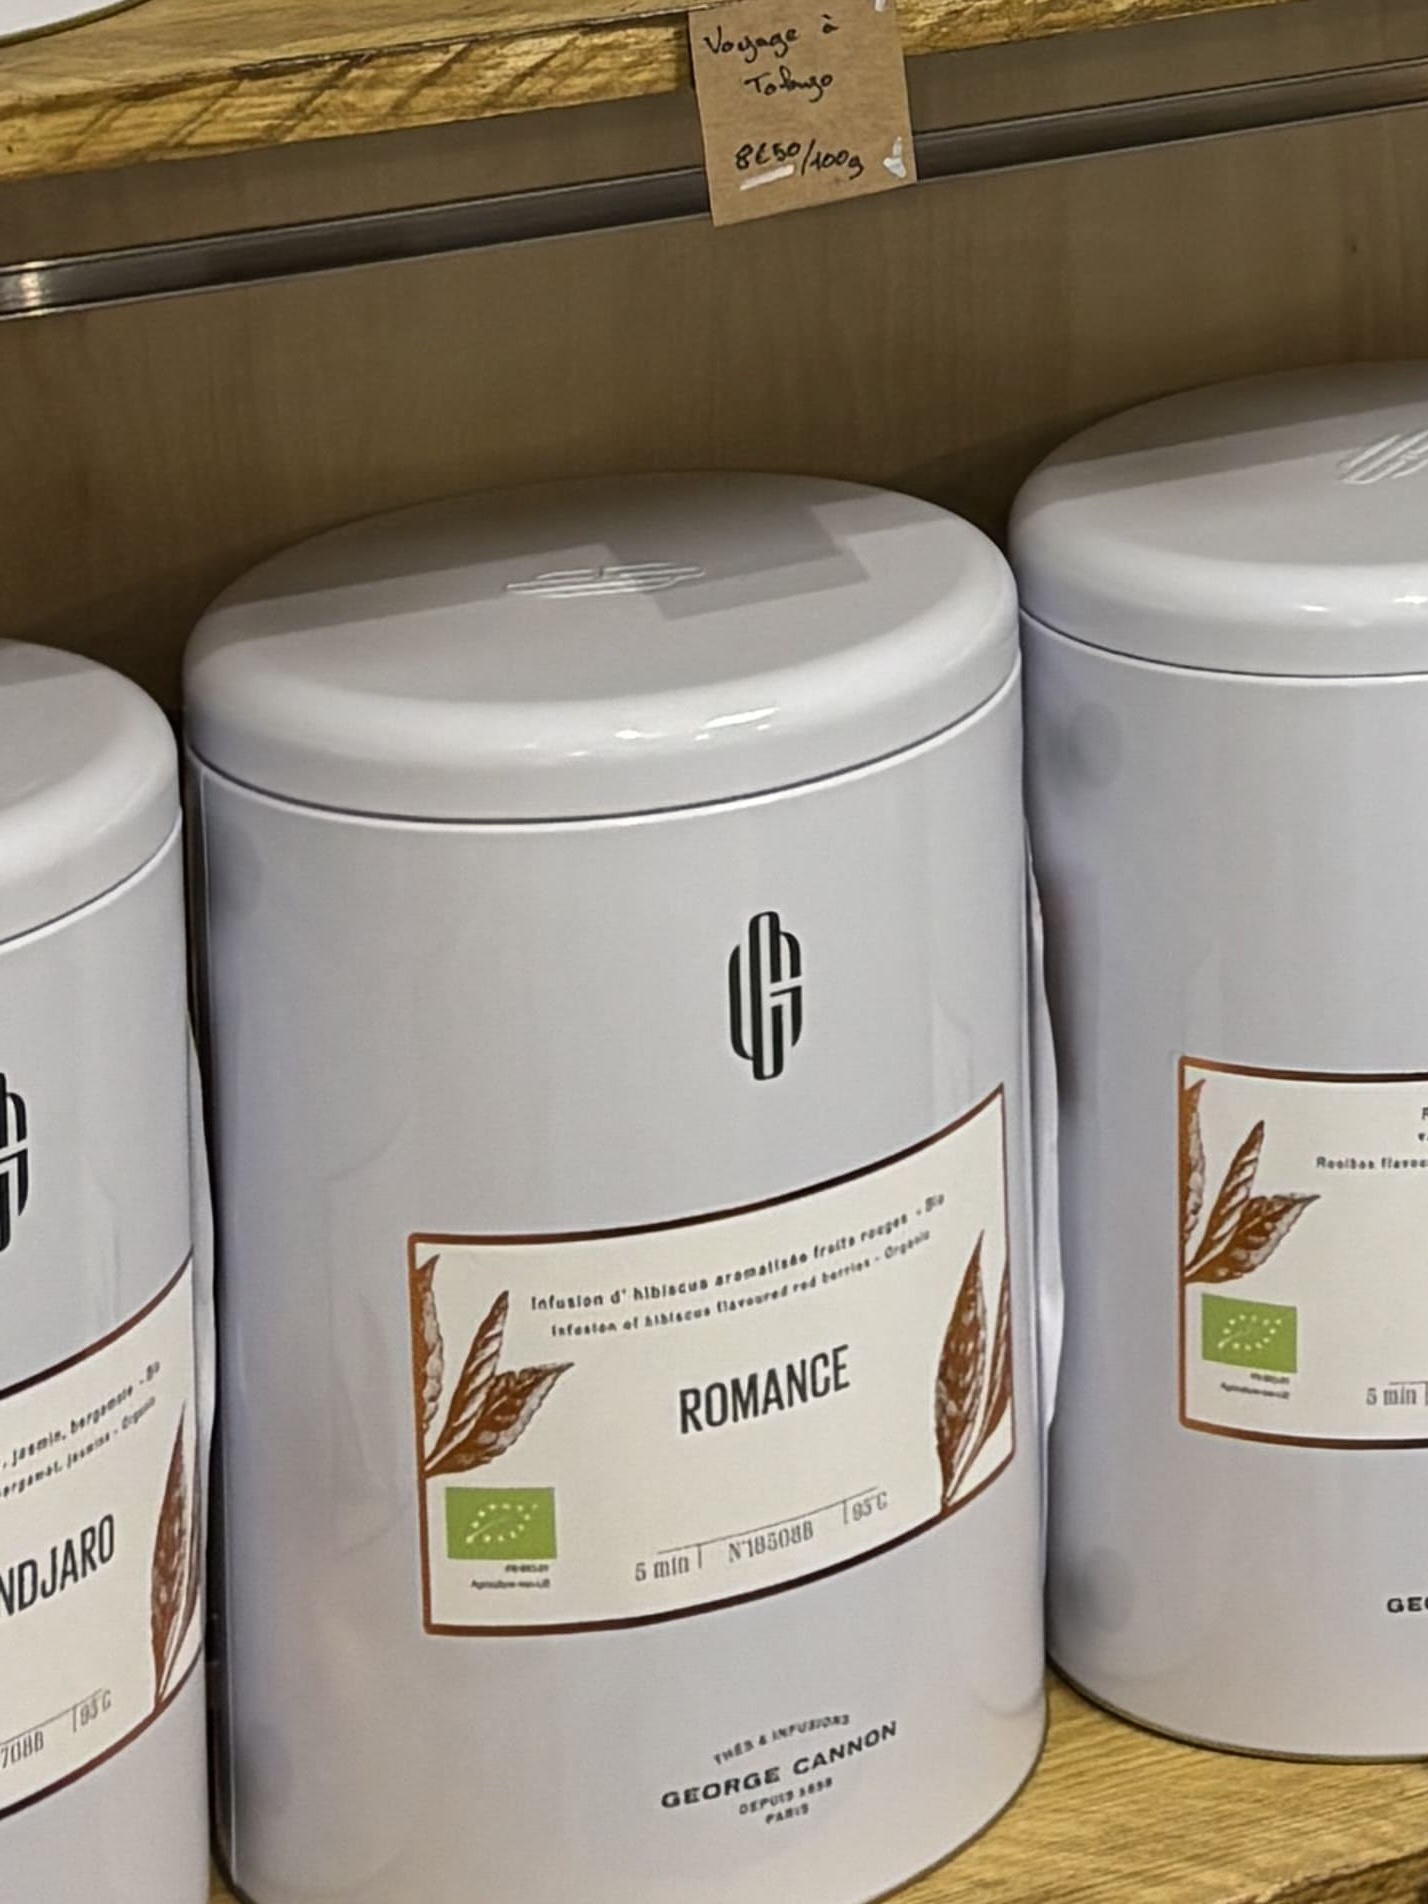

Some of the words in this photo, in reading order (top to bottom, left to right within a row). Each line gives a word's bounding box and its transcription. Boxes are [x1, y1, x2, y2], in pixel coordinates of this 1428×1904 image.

[703, 25, 798, 64] Voyage
[822, 14, 838, 34] à
[532, 1295, 603, 1310] Infusion
[633, 1279, 708, 1300] hibiscus
[680, 1344, 850, 1434] ROMANCE
[635, 1562, 646, 1581] 5
[654, 1557, 689, 1579] min
[661, 1767, 784, 1812] GEORGE
[793, 1716, 896, 1774] CANNON
